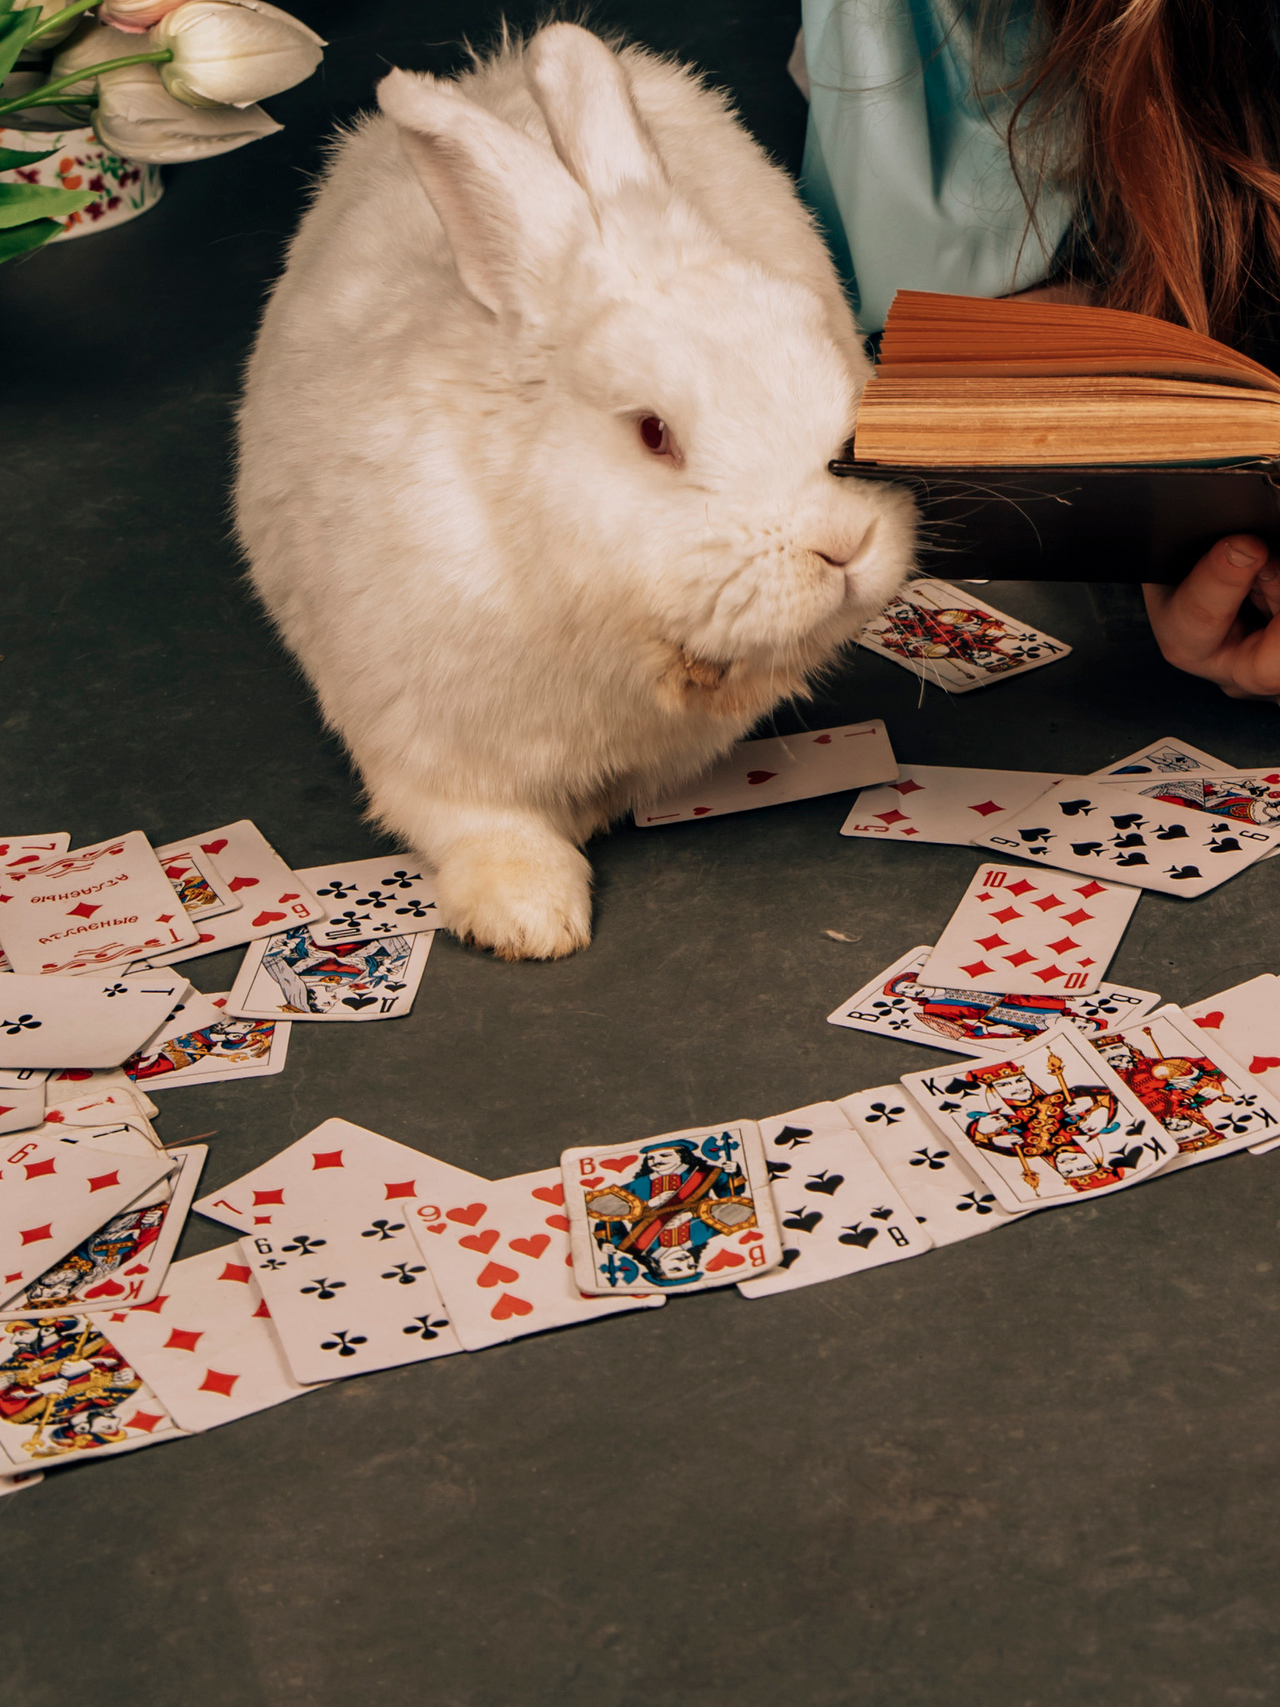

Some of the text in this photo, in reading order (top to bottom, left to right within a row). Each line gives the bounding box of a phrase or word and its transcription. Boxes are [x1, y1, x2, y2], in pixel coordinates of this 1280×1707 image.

[854, 822, 890, 832] 5
[983, 871, 1008, 889] 10
[170, 929, 183, 943] Т
[325, 926, 365, 941] 10
[1062, 972, 1088, 988] 10
[380, 997, 399, 1013] Д
[921, 1078, 947, 1096] К
[1249, 1108, 1278, 1128] К
[1144, 1137, 1167, 1161] К
[580, 1158, 595, 1175] В
[213, 1200, 242, 1214] 7
[418, 1206, 441, 1222] 9
[887, 1227, 909, 1246] 8
[255, 1238, 272, 1254] 6
[749, 1245, 766, 1267] В
[121, 1280, 143, 1300] К
